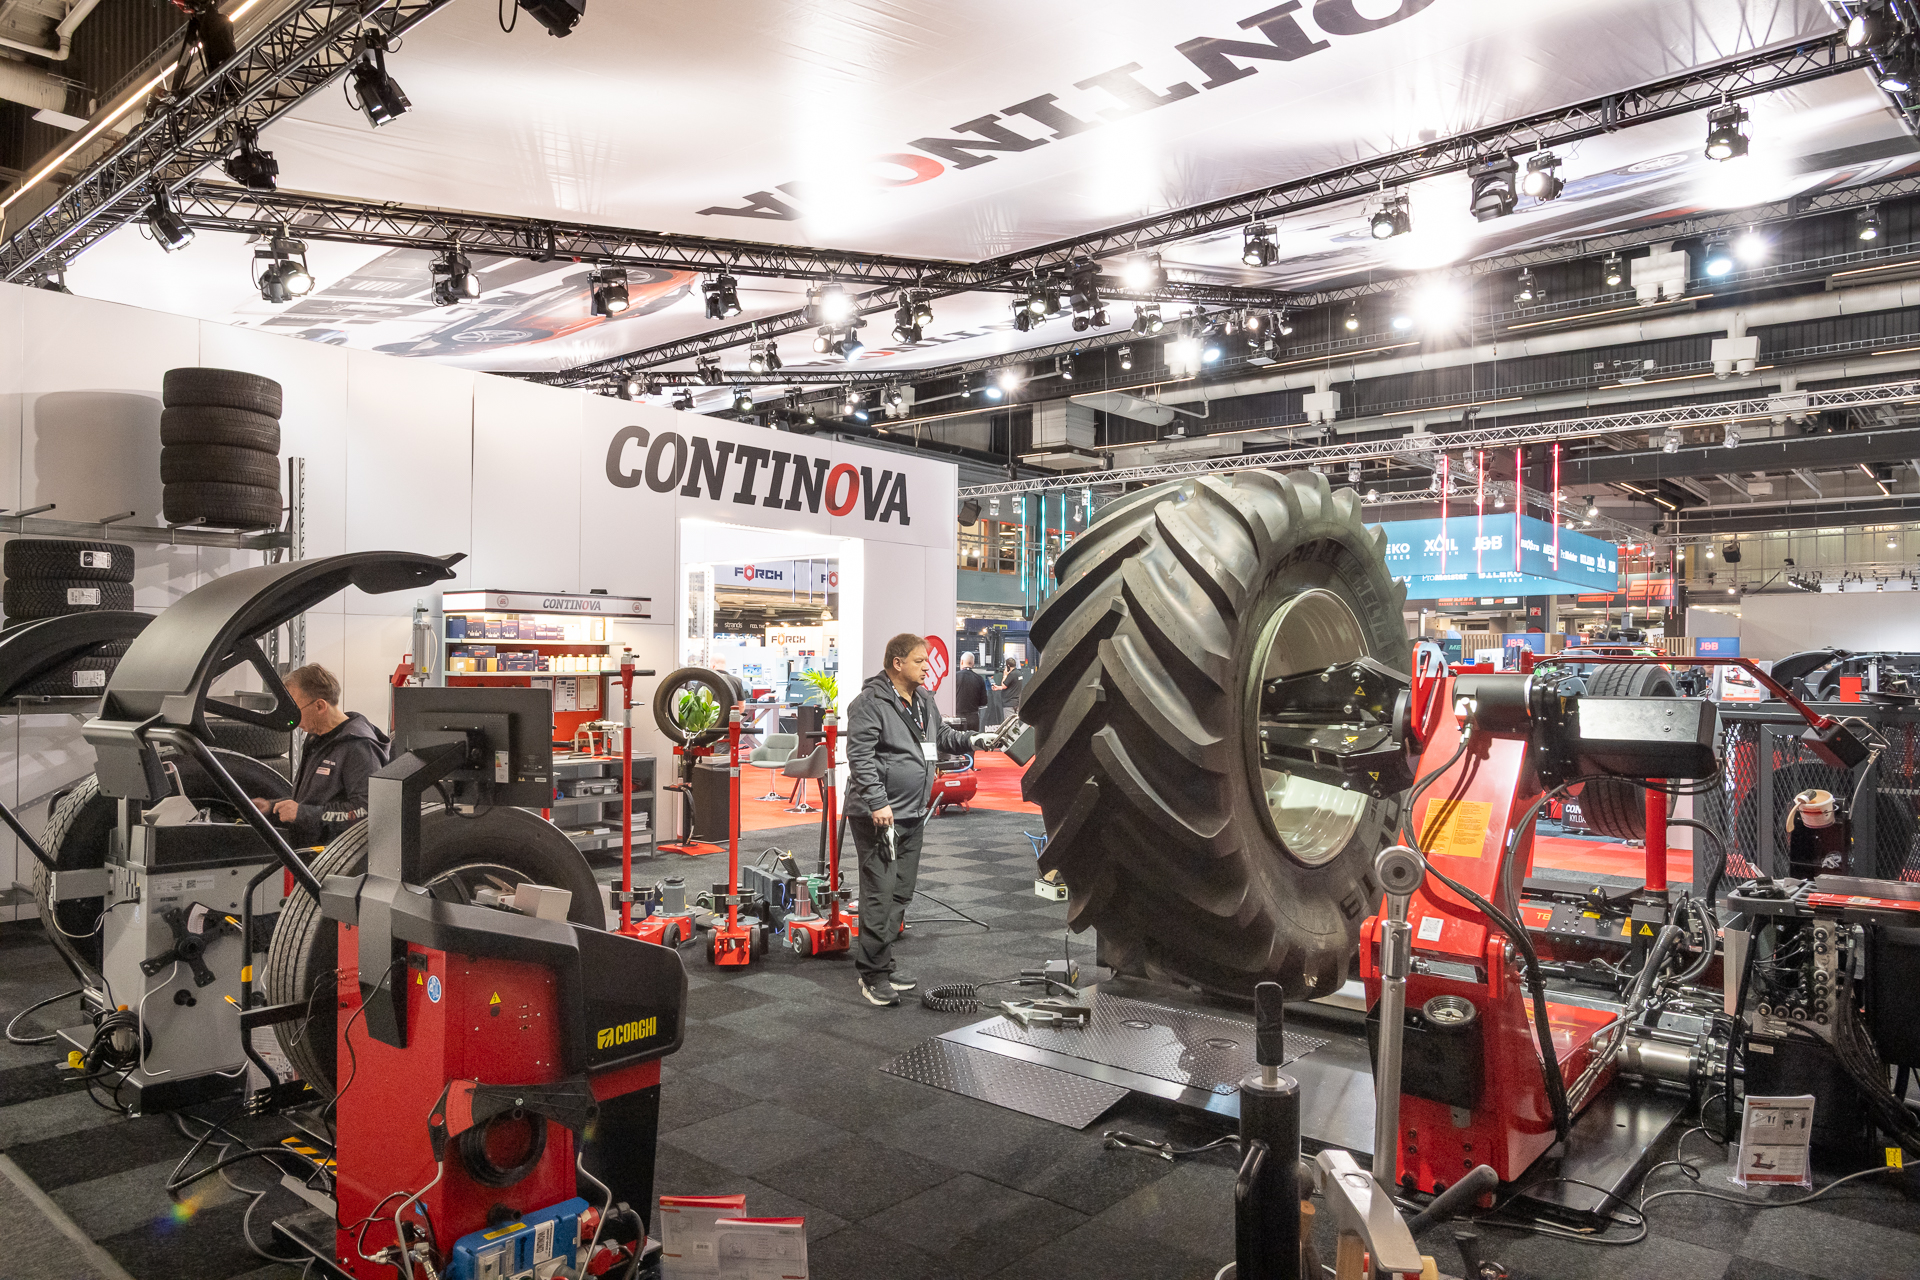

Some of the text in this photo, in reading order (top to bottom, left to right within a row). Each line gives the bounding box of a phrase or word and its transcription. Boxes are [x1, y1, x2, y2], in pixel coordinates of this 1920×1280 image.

[605, 425, 911, 526] CONTINOVA
[734, 564, 783, 582] FÖRCH
[542, 598, 602, 611] CONTINOVA
[771, 632, 806, 646] FÖRCH
[1699, 642, 1719, 651] J&B
[615, 1016, 657, 1045] CORGHI
